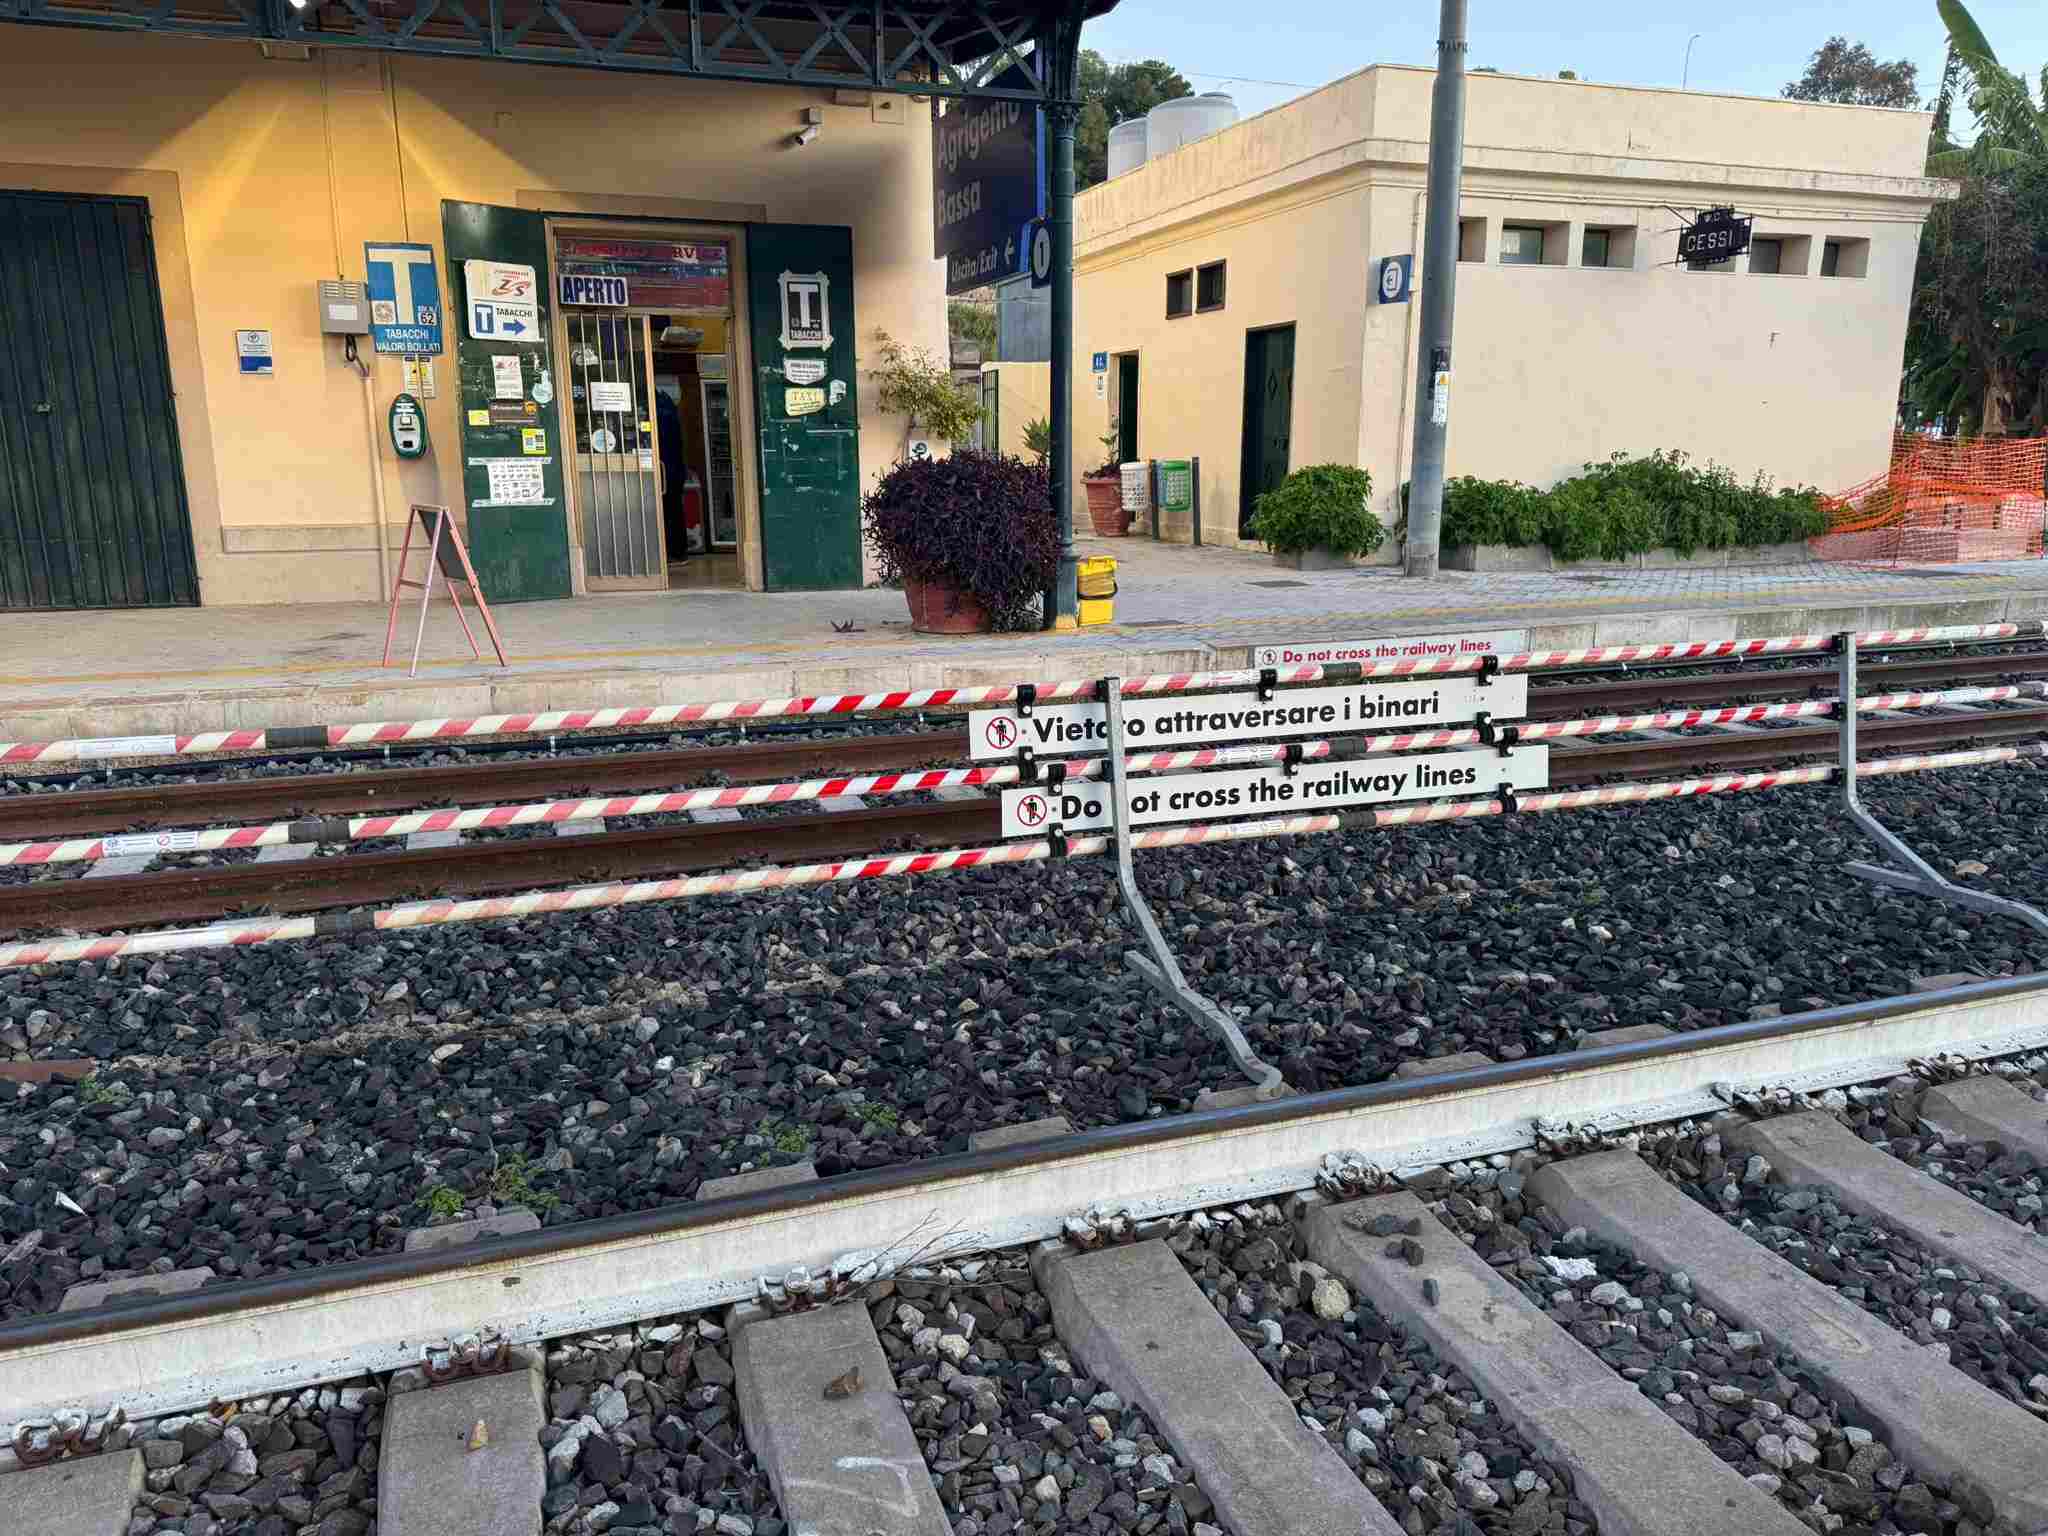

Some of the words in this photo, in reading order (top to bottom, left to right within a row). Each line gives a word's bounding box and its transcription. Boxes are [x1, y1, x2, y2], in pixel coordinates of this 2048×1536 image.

[937, 180, 982, 229] Bassa
[1687, 229, 1733, 252] CESSI
[368, 248, 432, 325] T
[563, 276, 626, 304] APERTO
[496, 307, 533, 318] TABACCHI
[788, 283, 819, 328] T
[420, 312, 434, 325] 62
[476, 307, 492, 331] T
[384, 328, 429, 339] TABACCHI
[376, 342, 406, 352] VALORI
[1283, 650, 1303, 663] Do
[1308, 649, 1331, 662] not
[1335, 648, 1371, 660] cross
[1376, 644, 1398, 657] the
[1403, 641, 1456, 655] railway
[1460, 639, 1492, 653] lines
[1155, 703, 1336, 735] attraversare
[1344, 697, 1350, 720] i
[1360, 691, 1439, 719] binari
[1061, 795, 1102, 820] Do
[1131, 790, 1160, 813] ot
[1169, 787, 1241, 809] cross
[1248, 777, 1294, 802] the
[1302, 771, 1408, 798] railway
[1416, 764, 1476, 788] lines
